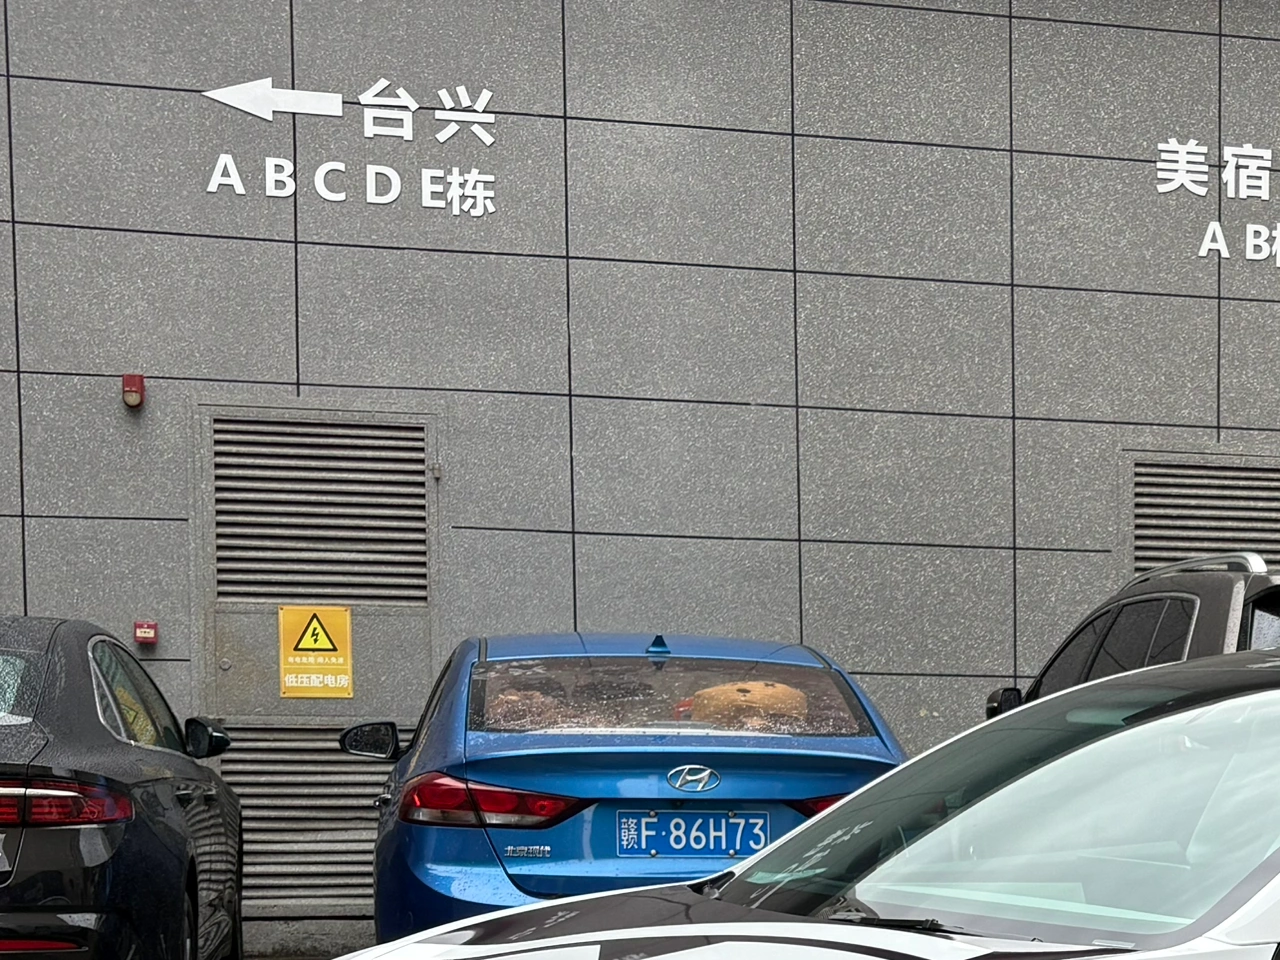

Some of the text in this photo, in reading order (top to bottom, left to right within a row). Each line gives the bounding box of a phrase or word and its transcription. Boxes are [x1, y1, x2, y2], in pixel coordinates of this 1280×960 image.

[358, 77, 495, 146] 台兴
[1156, 138, 1272, 200] 美宿
[285, 673, 349, 687] 低压配电房
[504, 845, 551, 858] 北京现代
